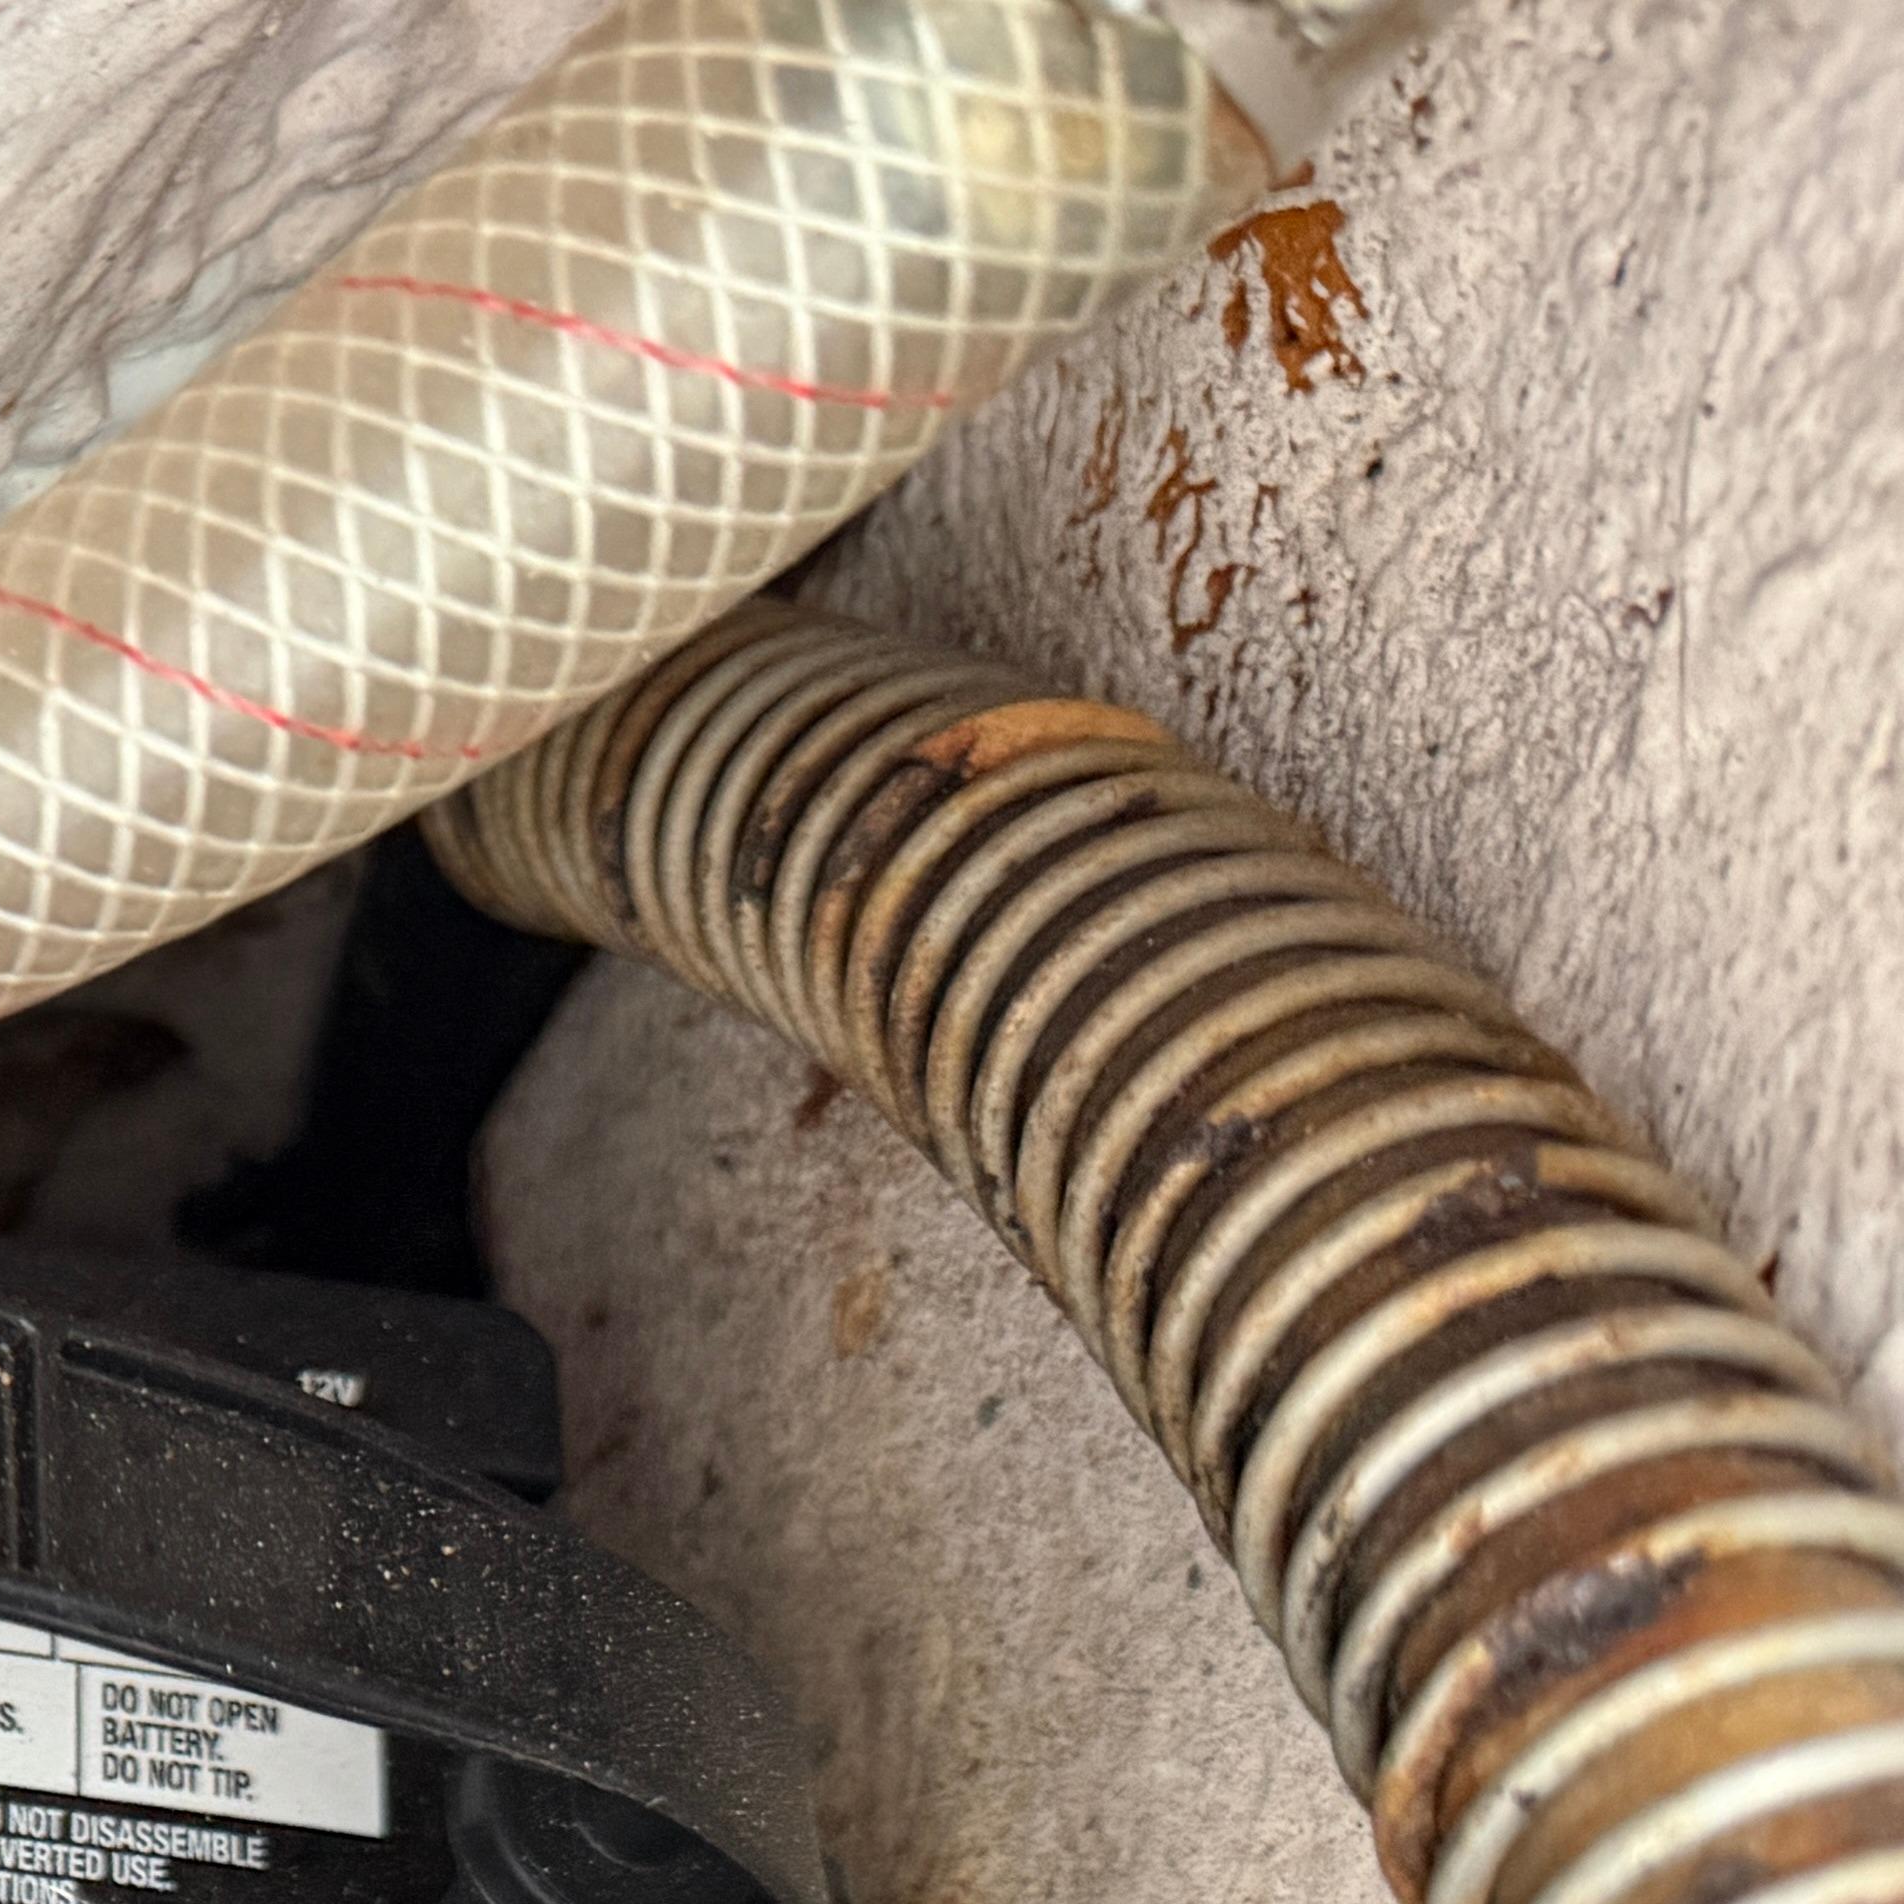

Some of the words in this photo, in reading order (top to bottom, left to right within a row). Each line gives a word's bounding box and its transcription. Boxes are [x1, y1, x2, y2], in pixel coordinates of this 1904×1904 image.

[101, 1682, 141, 1713] DO
[148, 1687, 200, 1721] NOT
[207, 1696, 283, 1735] OPEN
[101, 1717, 226, 1761] BATTERY.
[101, 1751, 141, 1785] DO
[148, 1757, 200, 1791] NOT
[207, 1765, 258, 1802] TIP.
[8, 1802, 67, 1842] NOT
[70, 1811, 271, 1870] DISASSEMBLE
[111, 1853, 175, 1892] USE.
